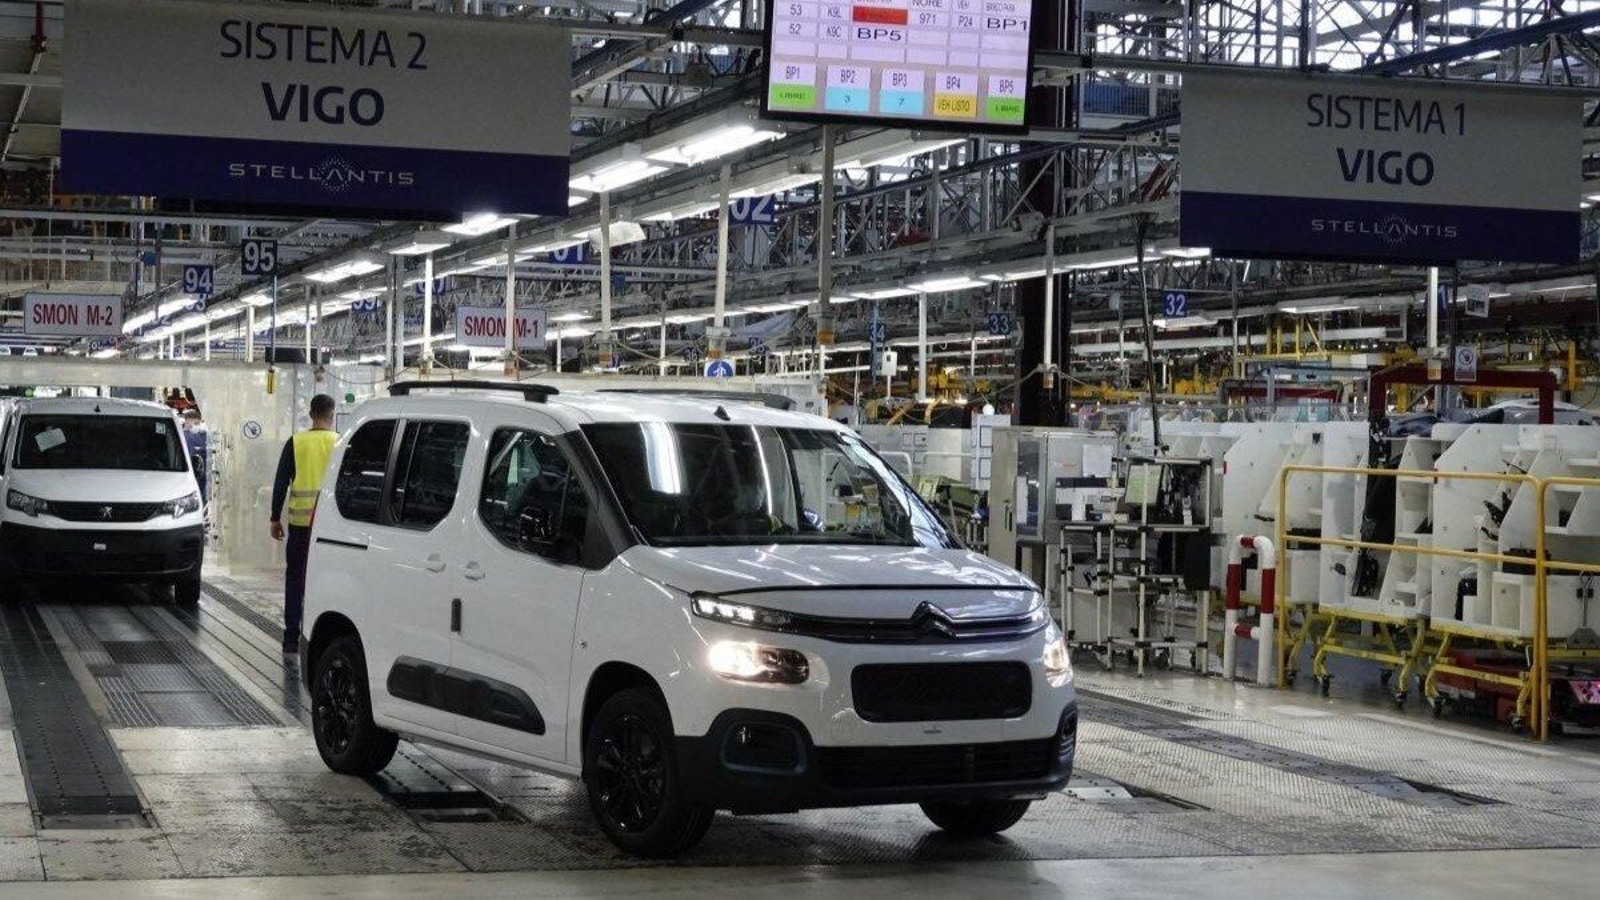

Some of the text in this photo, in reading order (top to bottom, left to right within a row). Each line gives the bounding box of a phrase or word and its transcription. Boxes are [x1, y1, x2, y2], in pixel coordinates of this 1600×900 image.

[790, 4, 802, 16] 53
[919, 13, 936, 24] 971
[987, 17, 1027, 31] BP1
[220, 19, 427, 70] SISTEMA 2
[789, 23, 801, 35] 52
[857, 28, 902, 41] BP5
[785, 66, 1013, 93] BP1 BP2 BP3 BP4 BP5
[261, 82, 385, 126] VIGO
[1307, 93, 1465, 136] SISTEMA 1
[229, 163, 415, 185] STELLANTIS
[1337, 147, 1434, 186] VIGO
[1311, 219, 1457, 237] STELLANTIS
[244, 242, 275, 272] 95
[184, 267, 213, 292] 94
[32, 303, 113, 326] SMON M-2
[1165, 293, 1186, 316] 32
[464, 315, 539, 338] SMON M-1
[990, 314, 1009, 334] 33
